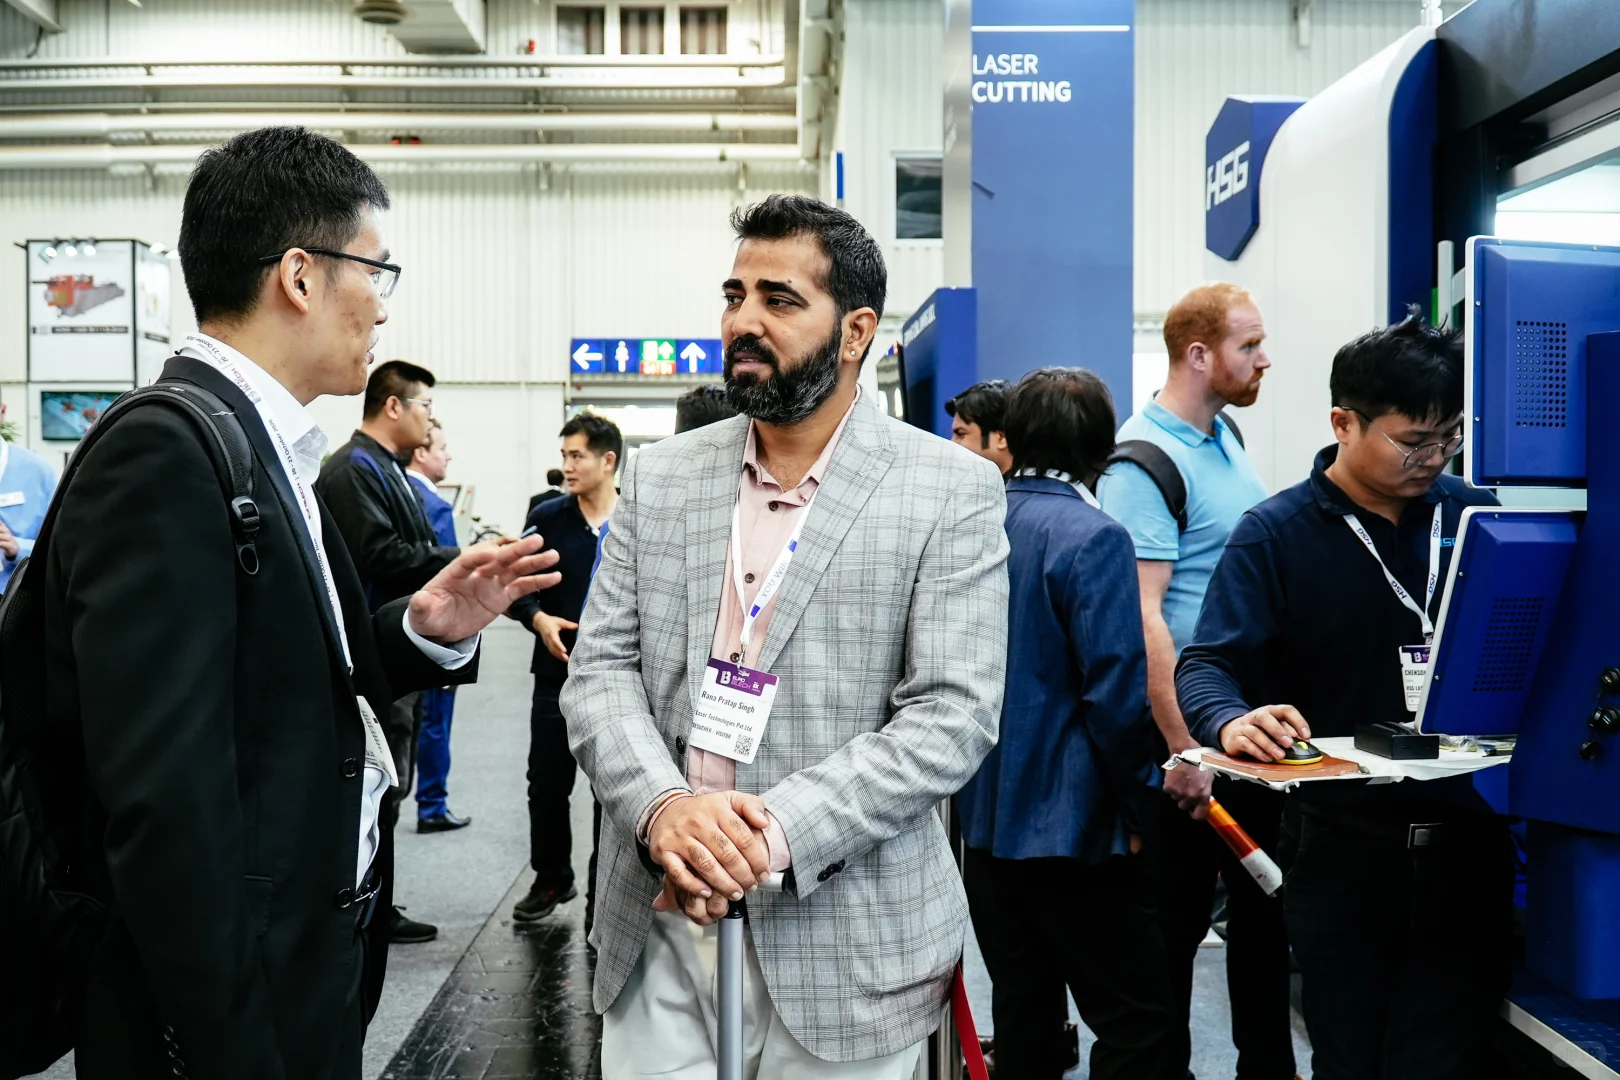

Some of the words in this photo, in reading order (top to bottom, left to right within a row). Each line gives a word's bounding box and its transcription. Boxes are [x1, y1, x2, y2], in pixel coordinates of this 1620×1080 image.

[972, 53, 1039, 75] LASER
[971, 80, 1072, 103] CUTTING
[1206, 139, 1250, 212] HSG
[1356, 527, 1373, 545] HSG
[1432, 519, 1440, 538] HSG
[761, 580, 775, 598] YOU
[1391, 580, 1408, 599] HSG
[1427, 572, 1436, 594] HSG
[701, 690, 717, 702] Rana
[717, 695, 738, 710] Pratap
[738, 701, 755, 714] Singh
[708, 711, 736, 727] Technologies
[744, 724, 753, 732] Ltd
[715, 730, 732, 739] VISITOR
